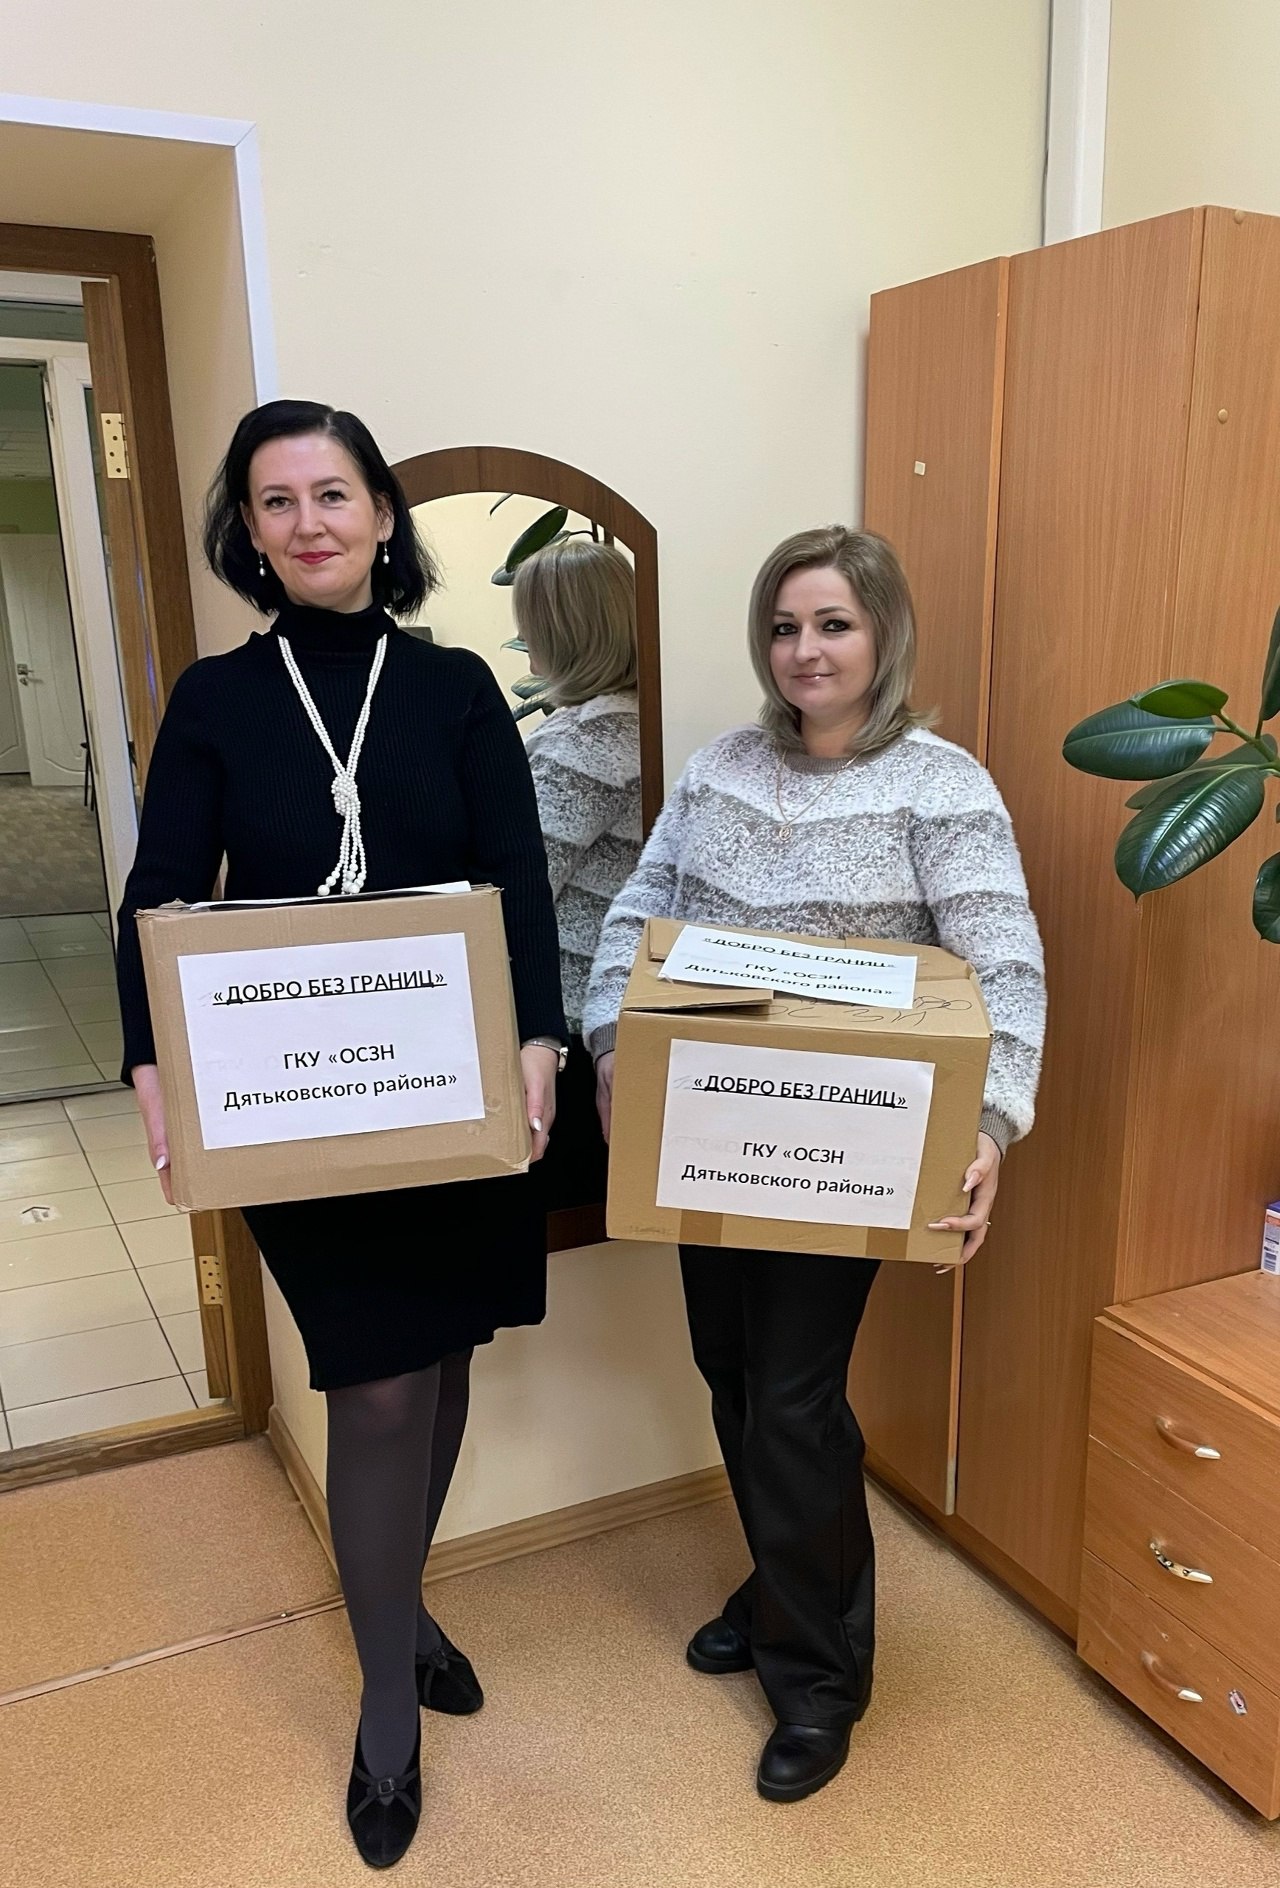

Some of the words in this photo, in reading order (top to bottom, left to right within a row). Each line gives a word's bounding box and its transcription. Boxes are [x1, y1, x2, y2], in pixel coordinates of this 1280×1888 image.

[702, 937, 776, 954] «ДОБРО
[780, 949, 811, 960] БЕЗ
[815, 955, 896, 968] ГРАНИЦ»
[212, 981, 302, 1005] «ДОБРО
[308, 977, 345, 998] БЕЗ
[350, 970, 448, 993] ГРАНИЦ»
[684, 963, 811, 988] Дятьковского
[815, 983, 893, 996] района»
[745, 963, 778, 973] ГКУ
[783, 970, 842, 980] «ОСЗН
[284, 1051, 321, 1069] ГКУ
[328, 1044, 395, 1065] «ОСЗН
[223, 1082, 367, 1111] Дятьковского
[373, 1072, 458, 1097] района»
[692, 1075, 775, 1096] «ДОБРО
[780, 1081, 814, 1099] БЕЗ
[819, 1085, 908, 1109] ГРАНИЦ»
[742, 1142, 777, 1158] ГКУ
[783, 1147, 845, 1165] «ОСЗН
[681, 1164, 811, 1189] Дятьковского
[816, 1178, 895, 1196] района»
